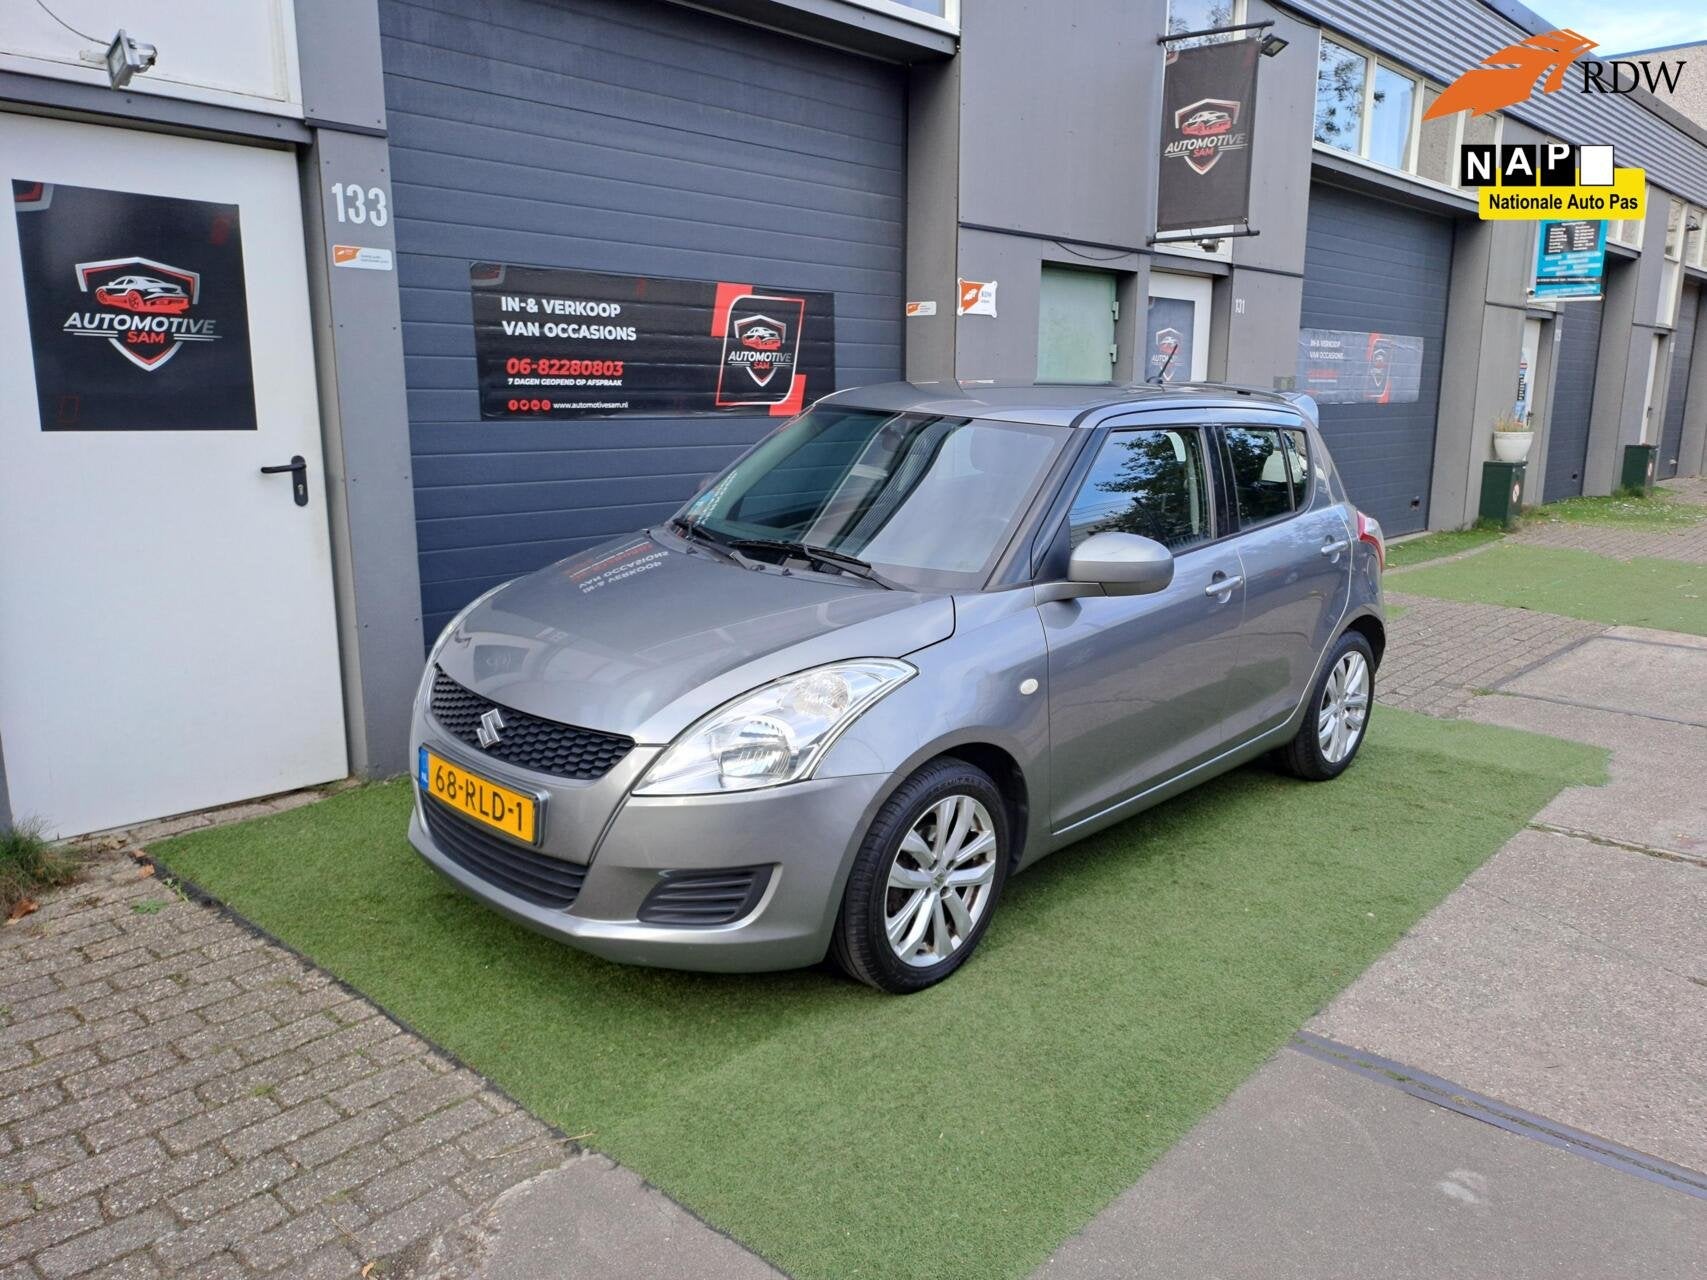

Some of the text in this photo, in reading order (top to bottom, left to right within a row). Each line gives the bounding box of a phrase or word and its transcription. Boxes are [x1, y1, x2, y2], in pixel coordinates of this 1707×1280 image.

[1164, 133, 1246, 154] AUTOMOTIVE
[1193, 148, 1215, 158] SAM
[331, 182, 388, 227] 133
[500, 296, 621, 318] IN-& VERKOOP
[64, 312, 216, 335] AUTOMOTIVE
[502, 321, 637, 341] VAN OCCASIONS
[127, 331, 165, 344] SAM
[728, 351, 792, 362] AUTOMOTIVE
[753, 361, 770, 370] SAM
[506, 358, 624, 376] 06-82280803
[508, 378, 623, 387] 7 DAGEN GEOPEND OP AFSPRAAK
[552, 401, 629, 409] www.automotivesam.nl
[435, 765, 522, 832] 68-RLD-1
